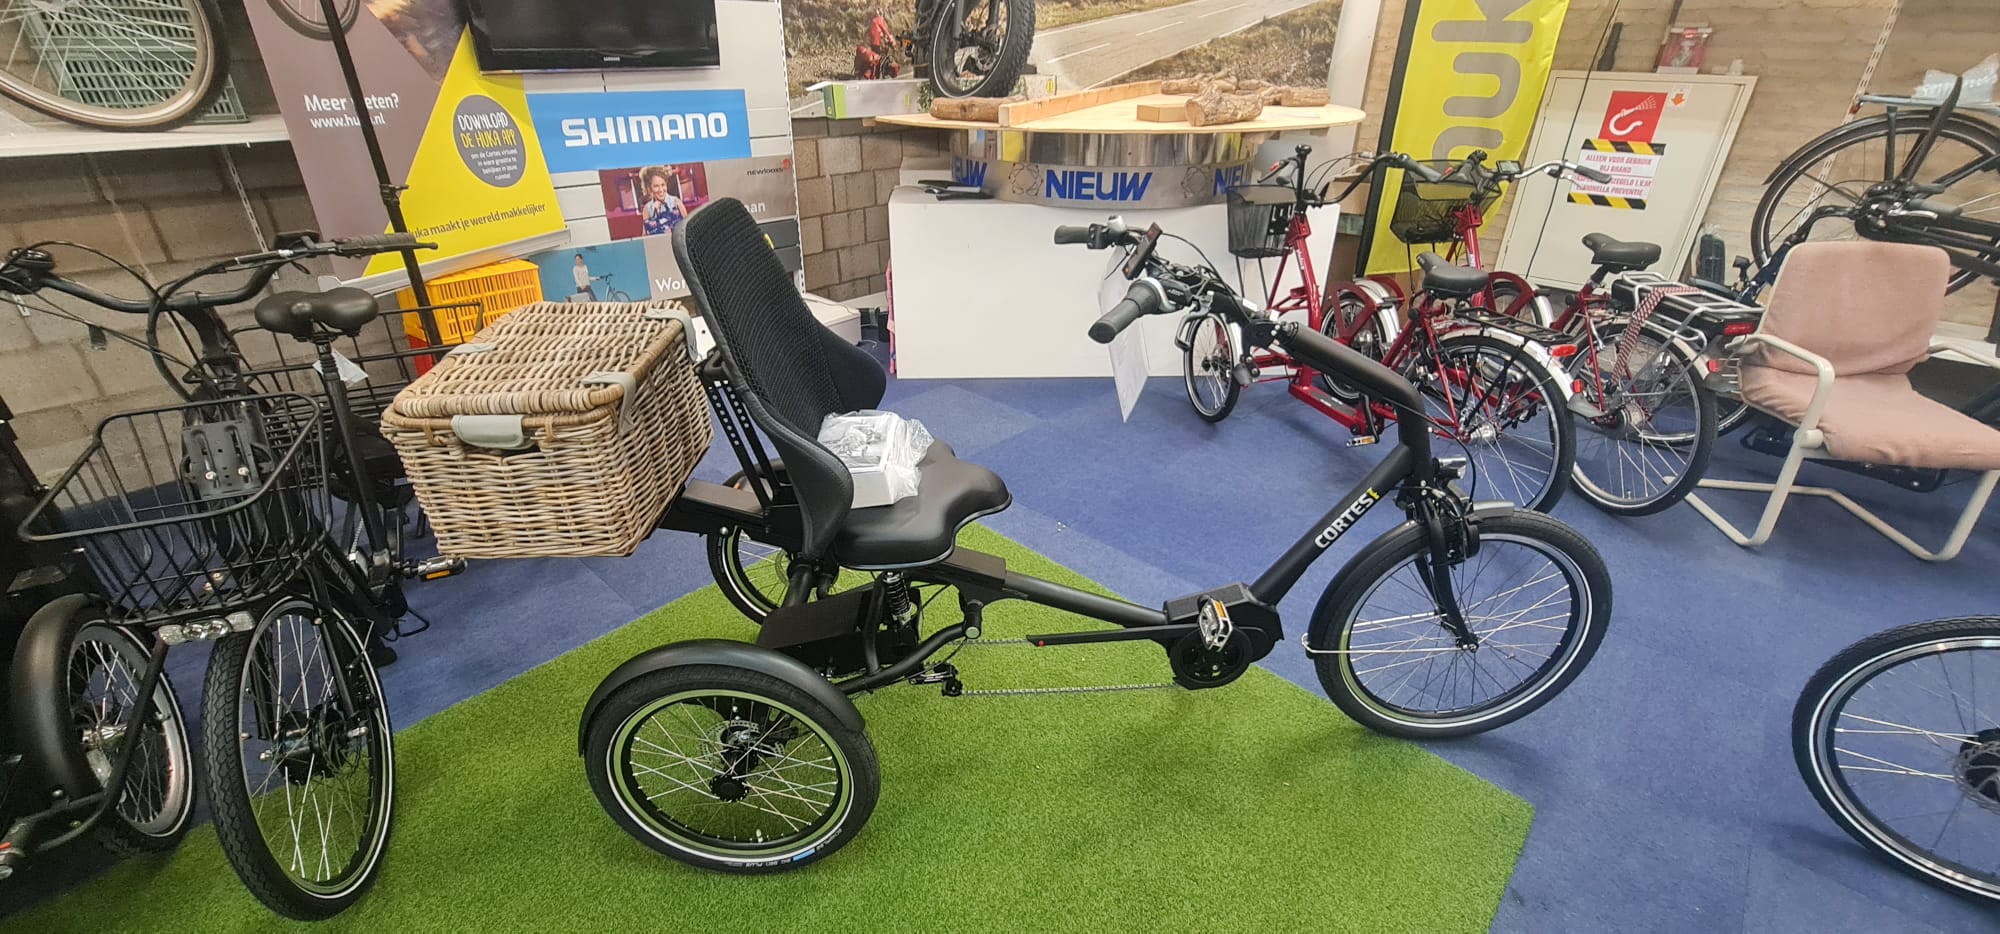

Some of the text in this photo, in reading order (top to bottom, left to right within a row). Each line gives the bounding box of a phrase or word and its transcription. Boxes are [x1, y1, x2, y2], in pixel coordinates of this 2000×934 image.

[304, 92, 399, 111] Meer eten?
[310, 111, 386, 128] www.hu.nl
[457, 112, 508, 130] DOWNLOAD
[561, 112, 728, 147] SHIMANO
[460, 128, 517, 148] DE HUKA APP
[1045, 169, 1153, 201] NIEUW
[408, 203, 546, 239] uka maakt je wereld makkelijker
[1314, 491, 1375, 549] CORTES
